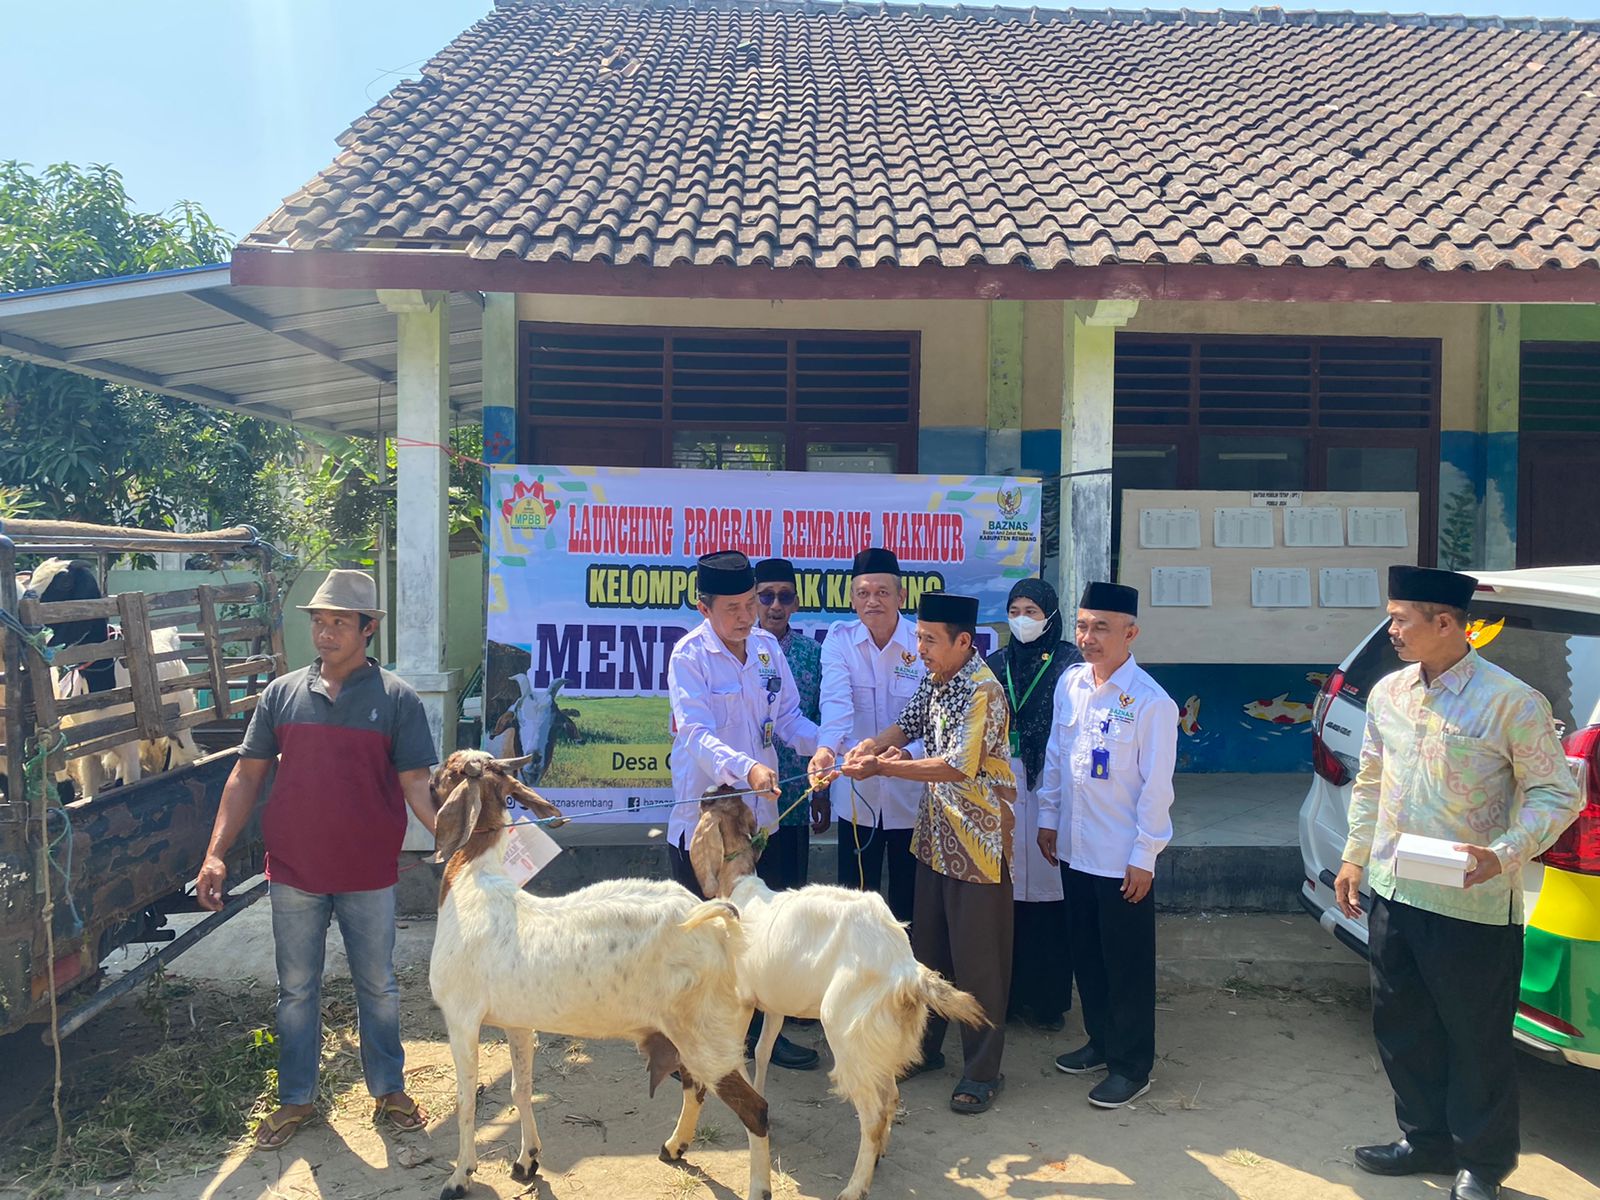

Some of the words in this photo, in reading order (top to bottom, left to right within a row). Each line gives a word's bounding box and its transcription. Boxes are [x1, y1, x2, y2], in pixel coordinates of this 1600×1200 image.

[515, 513, 541, 525] MPBB
[988, 520, 1029, 531] BAZNAS
[568, 504, 674, 556] LAUNCHING
[683, 508, 772, 558] PROGRAM
[782, 510, 872, 559] REMBANG
[882, 512, 965, 562] MAKMUR
[589, 568, 699, 605] KELOMPO
[612, 752, 658, 771] Desa
